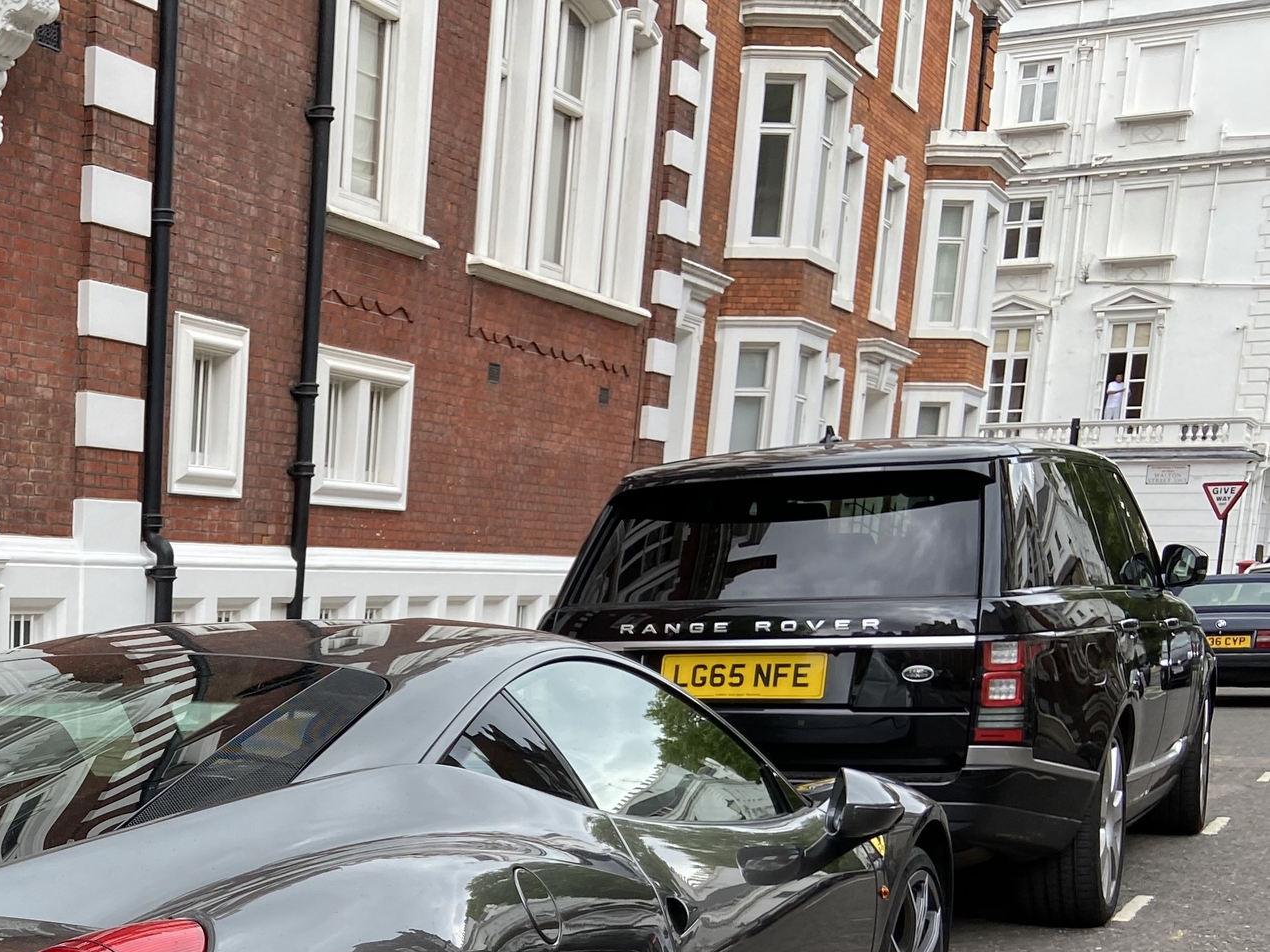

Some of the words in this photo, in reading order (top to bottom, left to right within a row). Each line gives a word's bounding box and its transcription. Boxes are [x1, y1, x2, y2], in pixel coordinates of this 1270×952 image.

[1212, 486, 1236, 494] GIVE
[620, 622, 729, 635] RANGE
[754, 618, 881, 632] ROVER
[1224, 636, 1246, 646] CYP
[673, 663, 746, 688] LG65
[754, 663, 811, 688] NFE
